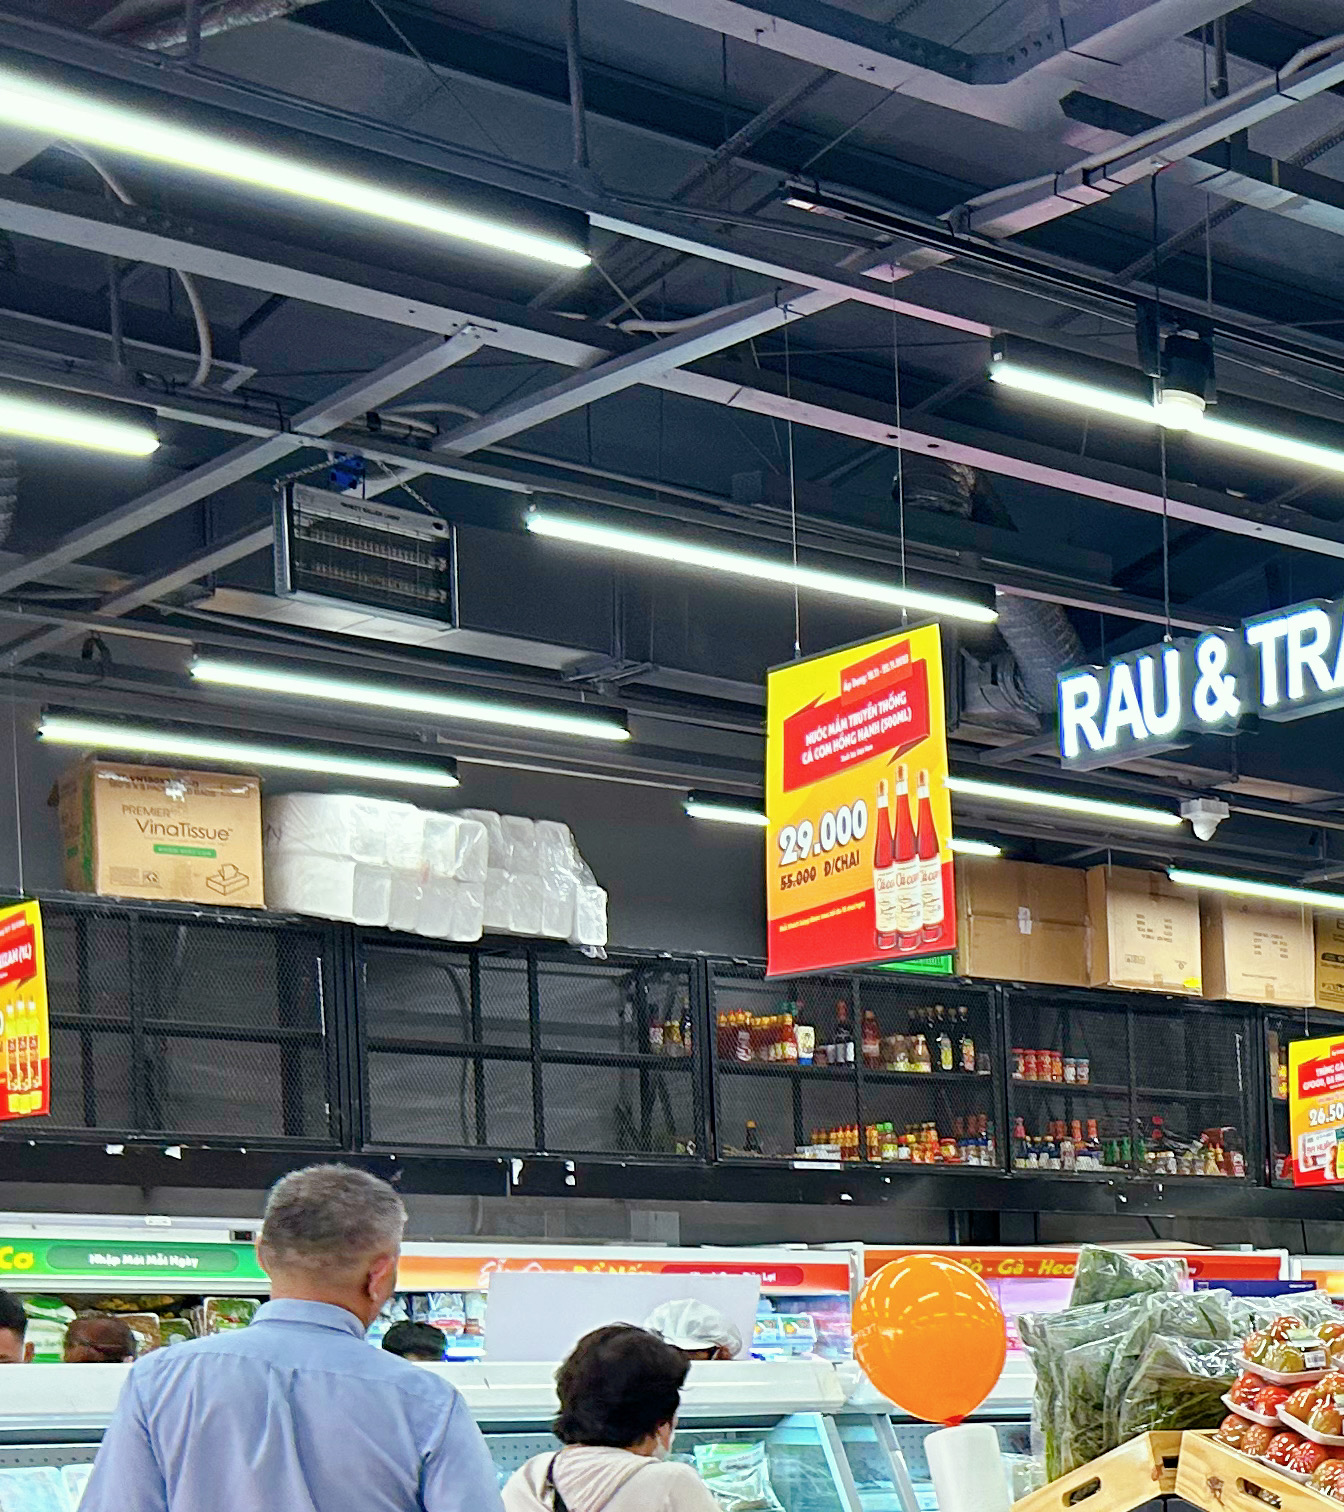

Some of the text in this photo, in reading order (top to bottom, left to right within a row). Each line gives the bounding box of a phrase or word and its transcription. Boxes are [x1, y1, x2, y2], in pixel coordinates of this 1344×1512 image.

[1058, 652, 1181, 760] RAU
[1196, 636, 1240, 723] &
[122, 804, 170, 818] PREMIER
[136, 818, 230, 841] VinaTissue
[778, 798, 868, 867] 29.000
[998, 1256, 1077, 1275] Gà Heo
